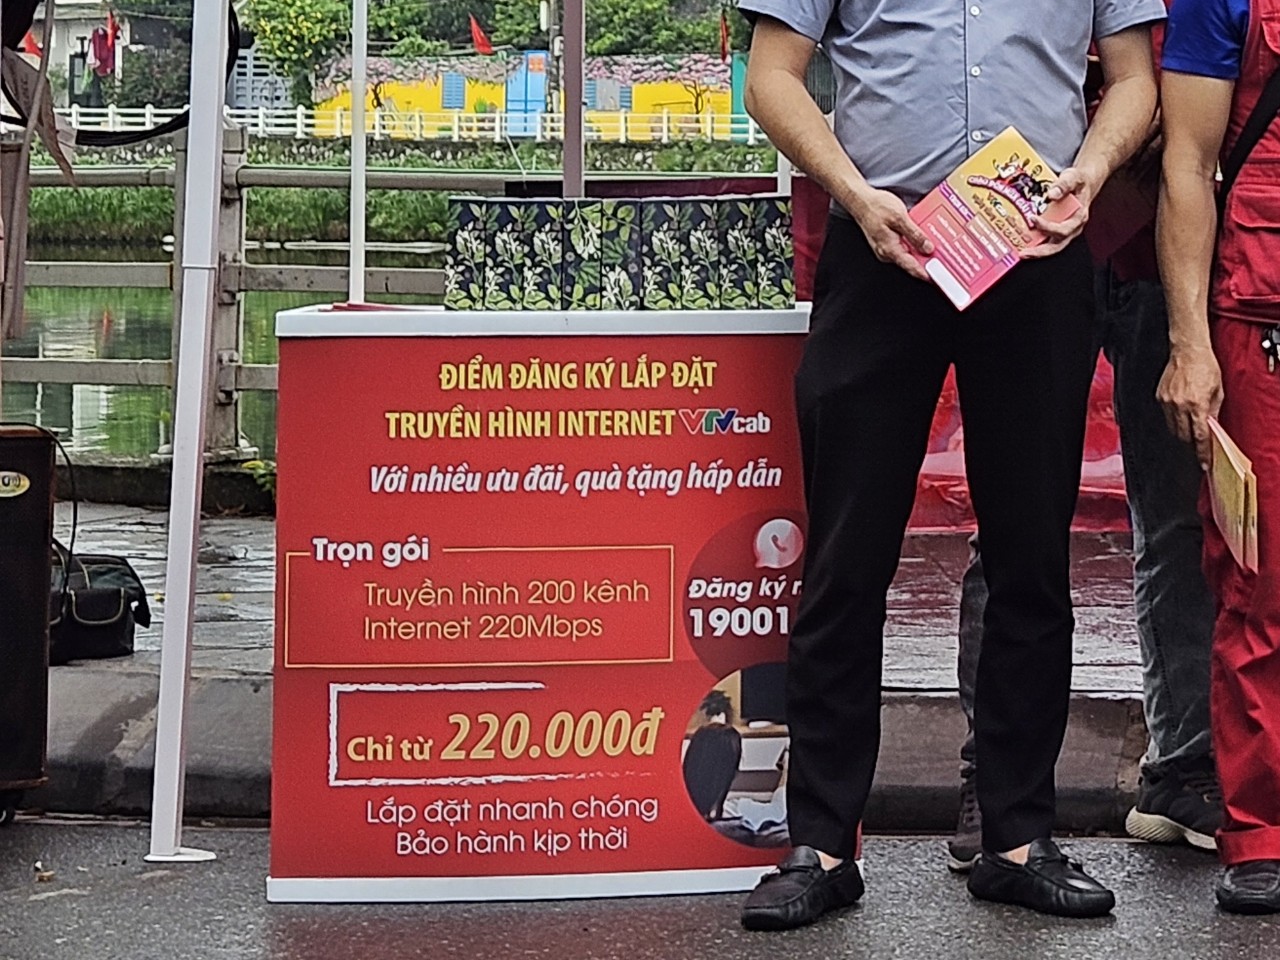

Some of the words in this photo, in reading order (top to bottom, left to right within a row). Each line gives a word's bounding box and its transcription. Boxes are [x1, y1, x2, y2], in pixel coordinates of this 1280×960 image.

[440, 354, 503, 390] ĐIỂM
[508, 357, 577, 390] ĐĂNG
[585, 357, 615, 389] KÝ
[621, 354, 666, 388] LẮP
[671, 355, 717, 394] ĐẶT
[385, 404, 480, 438] TRUYỀN
[488, 407, 550, 437] HÌNH
[558, 410, 676, 437] INTERNET
[679, 408, 771, 434] VTVcab
[370, 462, 406, 493] Với
[412, 462, 479, 492] nhiều
[486, 468, 518, 492] ưu
[523, 464, 569, 494] đãi,
[576, 464, 620, 497] quà
[626, 464, 681, 497] tặng
[687, 459, 731, 494] hấp
[737, 457, 782, 487] dẫn
[313, 538, 373, 567] Trọn
[382, 535, 429, 568] gói
[364, 578, 453, 611] Truyền
[462, 581, 519, 605] hình
[528, 581, 575, 604] 200
[584, 579, 649, 603] kênh
[688, 577, 753, 603] Đăng
[759, 574, 787, 600] ký
[364, 616, 472, 640] Internet
[479, 614, 603, 642] 220Mbps
[347, 735, 393, 761] Chỉ
[400, 736, 433, 761] từ
[440, 707, 665, 760] 220.000đ
[367, 797, 417, 827] Lắp
[424, 799, 472, 827] đặt
[479, 797, 565, 821] nhanh
[572, 794, 658, 821] chóng
[397, 828, 449, 856] Bảo
[457, 829, 525, 854] hành
[534, 829, 571, 857] kịp
[579, 827, 628, 850] thời
